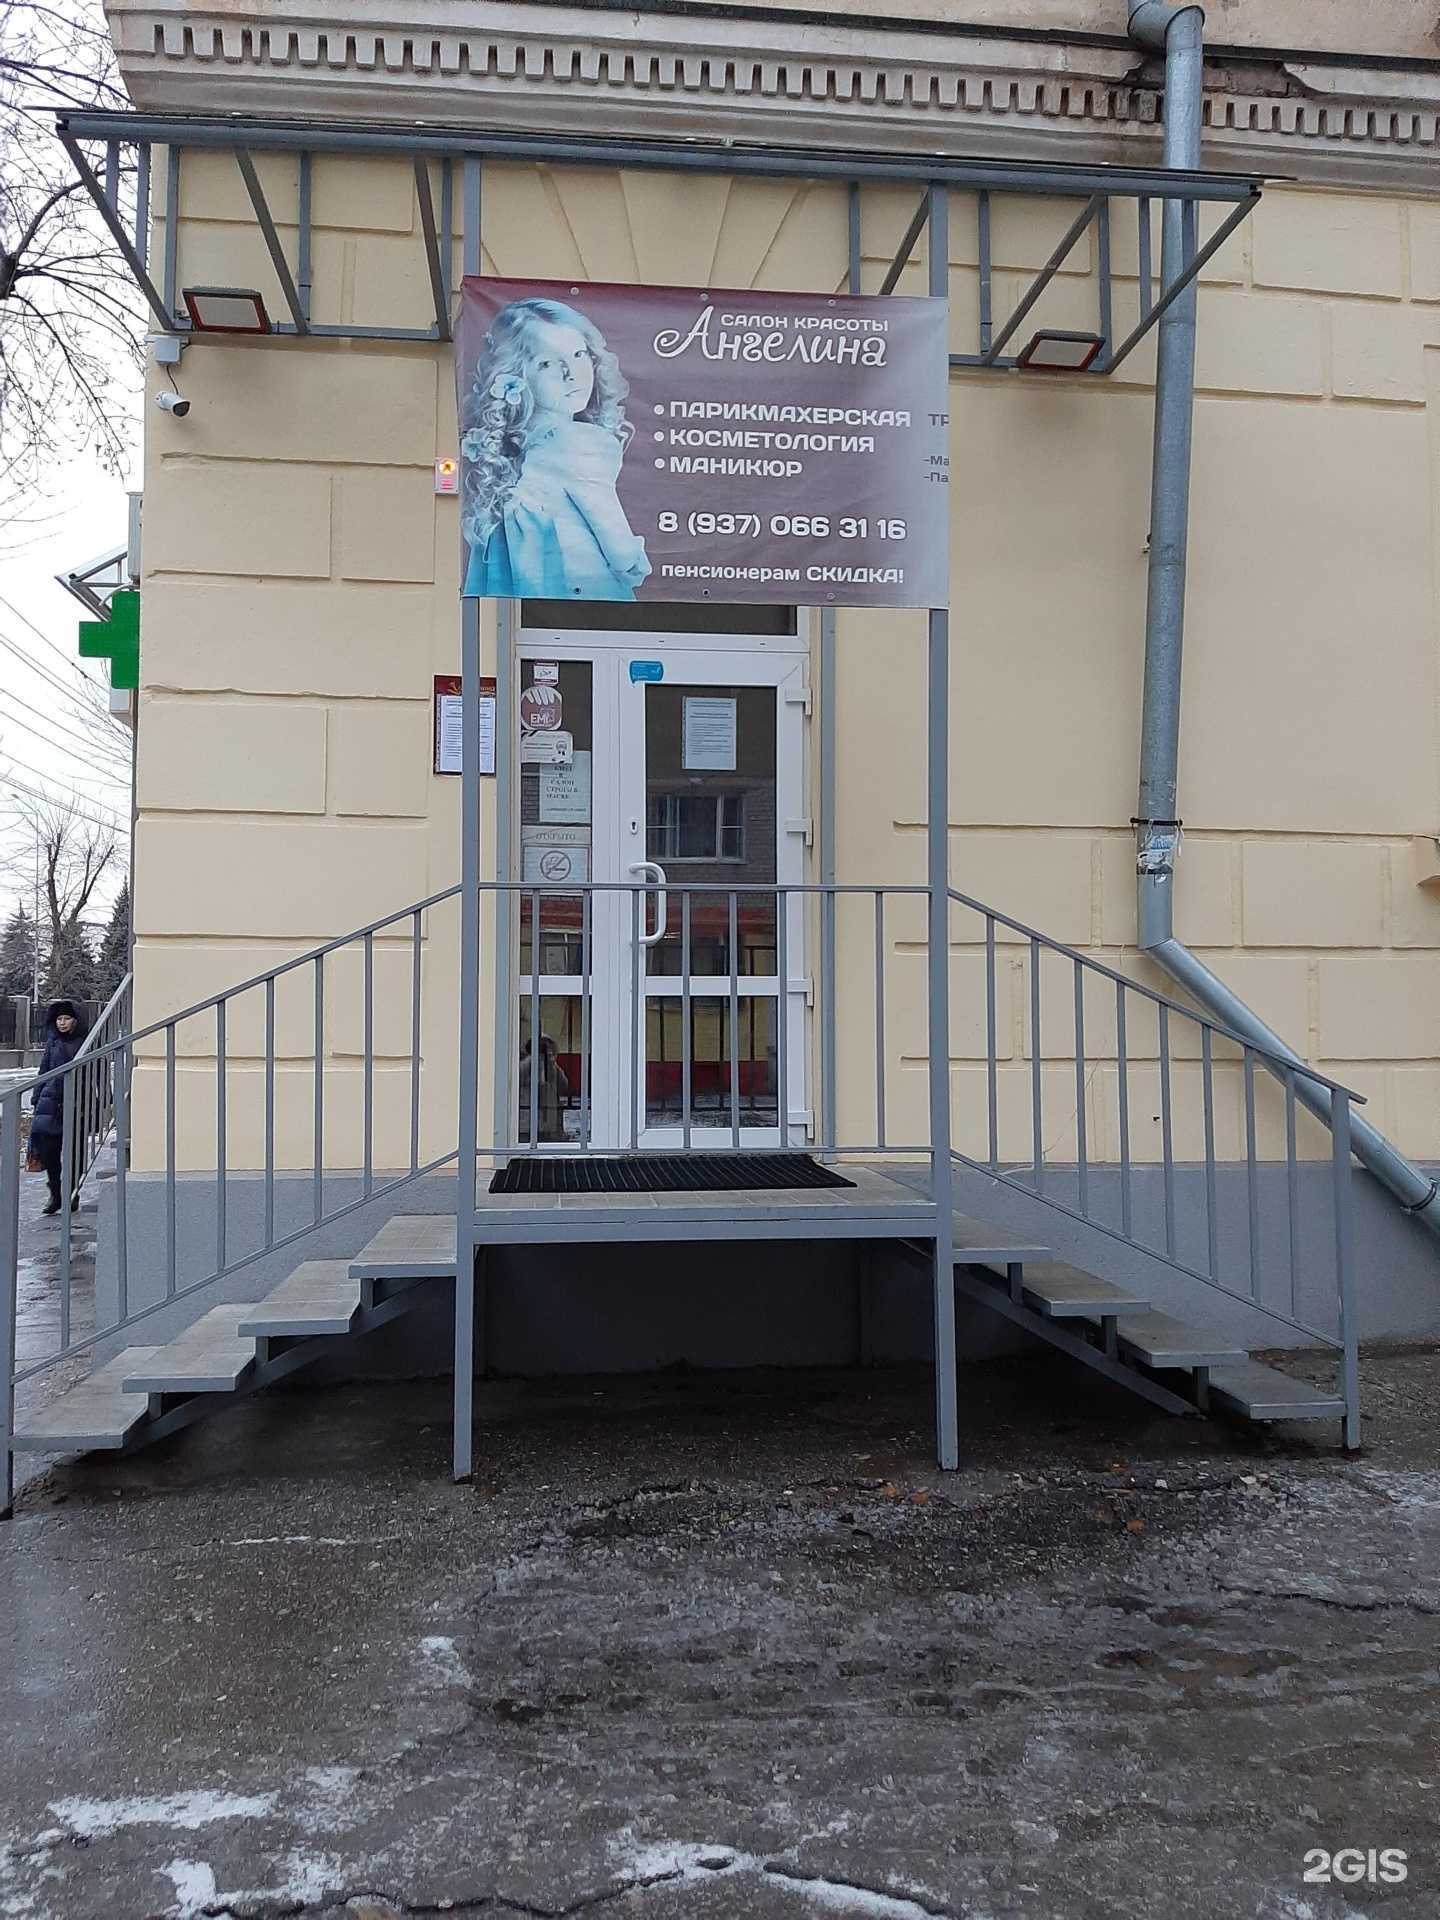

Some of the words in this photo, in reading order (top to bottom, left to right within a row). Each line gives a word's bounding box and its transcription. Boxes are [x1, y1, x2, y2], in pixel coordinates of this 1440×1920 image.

[721, 313, 788, 329] САЛОН
[794, 317, 889, 332] КРАСОТЫ
[653, 305, 888, 367] Ангелина
[670, 401, 911, 428] ПАРИКМАХЕРСКАЯ
[670, 428, 875, 453] КОСМЕТОЛОГИЯ
[670, 456, 803, 478] МАНИКЮР
[658, 511, 679, 532] 8
[688, 511, 761, 538] (937)
[770, 515, 830, 537] 066
[839, 518, 868, 538] 31
[877, 519, 907, 539] 16
[661, 564, 800, 582] пенсионерам
[806, 566, 904, 584] СКИДКА!
